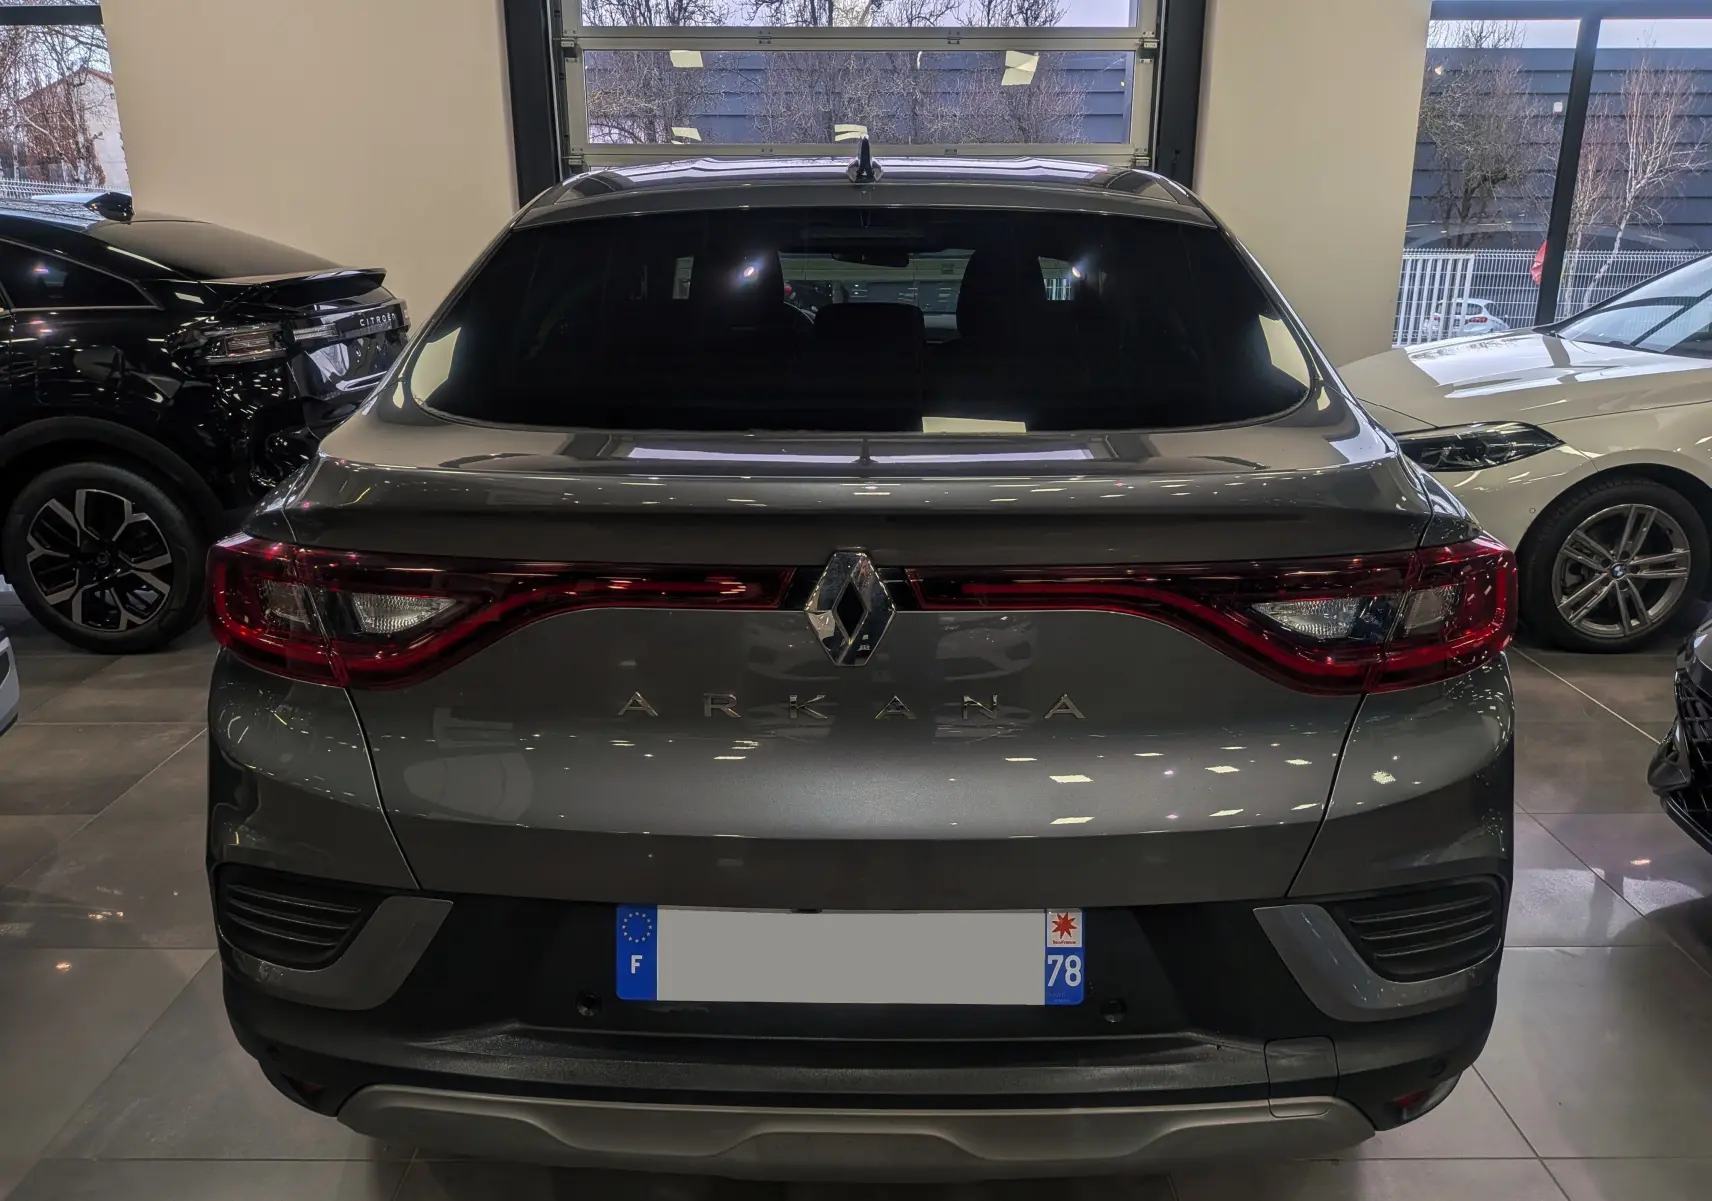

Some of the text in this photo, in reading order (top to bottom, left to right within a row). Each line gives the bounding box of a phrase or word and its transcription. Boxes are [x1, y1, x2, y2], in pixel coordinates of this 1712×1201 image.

[617, 691, 1086, 720] ARKANA
[631, 954, 643, 974] F
[1047, 954, 1082, 987] 78
